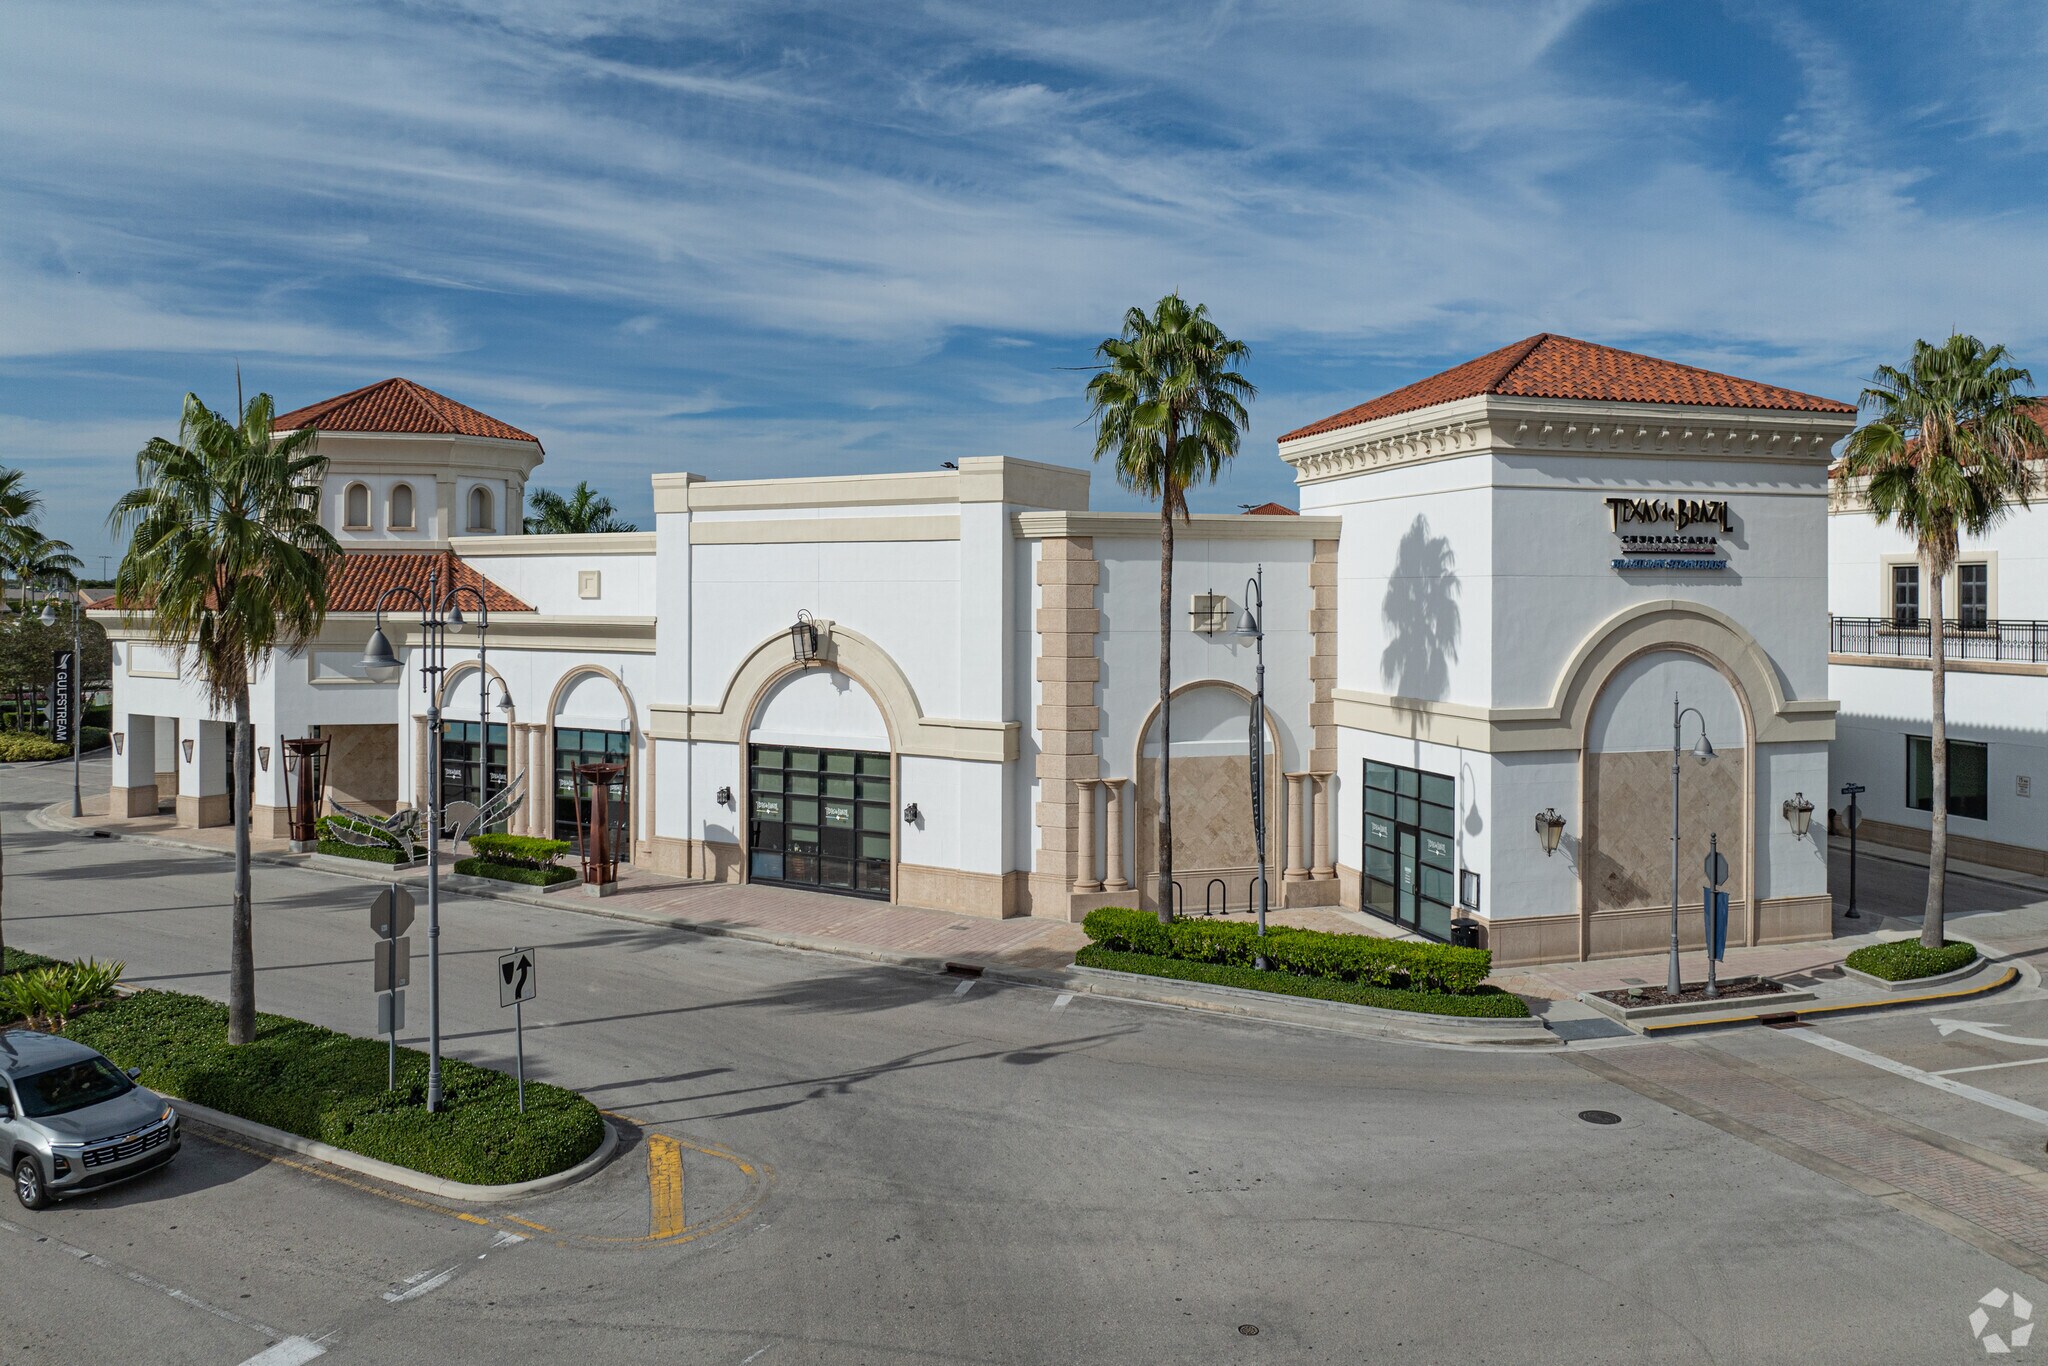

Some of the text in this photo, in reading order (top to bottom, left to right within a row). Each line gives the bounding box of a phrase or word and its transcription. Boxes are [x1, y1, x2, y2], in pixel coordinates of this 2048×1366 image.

[1604, 498, 1660, 532] TEXAS
[1660, 502, 1675, 521] de
[1621, 535, 1717, 545] CHURRASCARIA
[56, 671, 68, 741] GULFSTREAM
